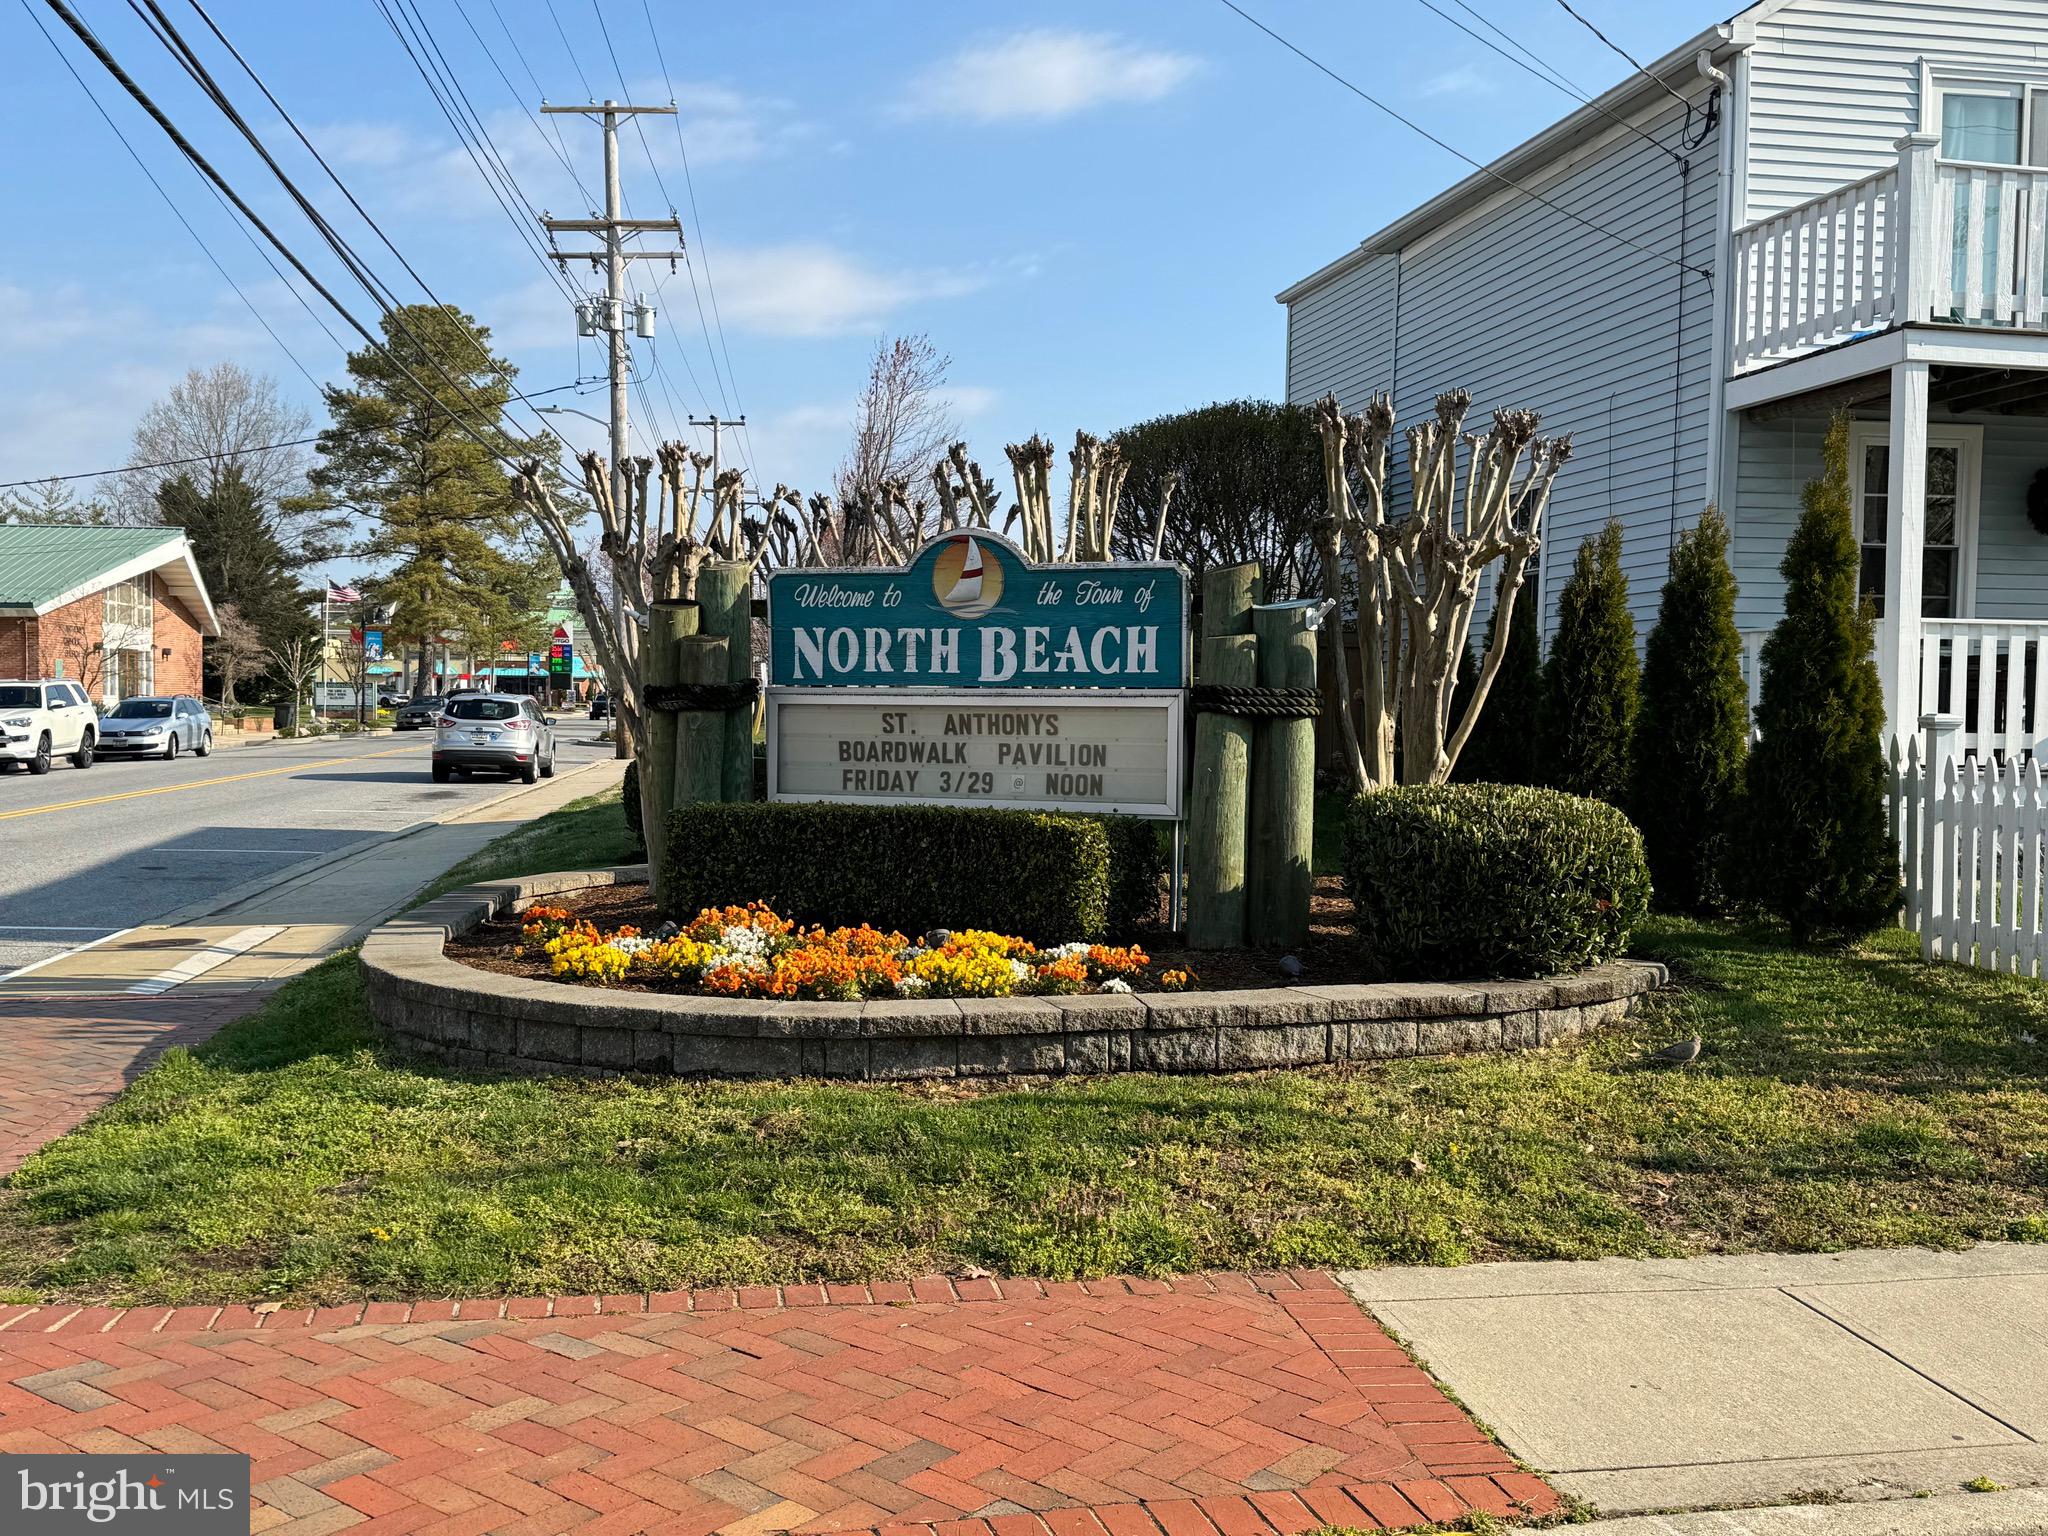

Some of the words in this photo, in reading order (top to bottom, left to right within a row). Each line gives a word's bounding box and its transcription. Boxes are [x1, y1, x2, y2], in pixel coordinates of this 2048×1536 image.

[794, 583, 875, 608] Welcome
[882, 582, 902, 608] to
[1037, 580, 1063, 606] the
[1075, 580, 1123, 606] Town
[1134, 579, 1156, 614] of
[792, 627, 961, 680] NORTH
[977, 625, 1160, 682] BEACH
[882, 712, 917, 735] ST.
[943, 713, 1059, 736] ANTHONYS
[838, 740, 967, 764] BOARDWALK
[998, 743, 1107, 767] PAVILION
[842, 769, 920, 792] FRIDAY
[939, 771, 994, 794] 3/29
[1012, 776, 1025, 790] @
[1045, 773, 1104, 797] NOON
